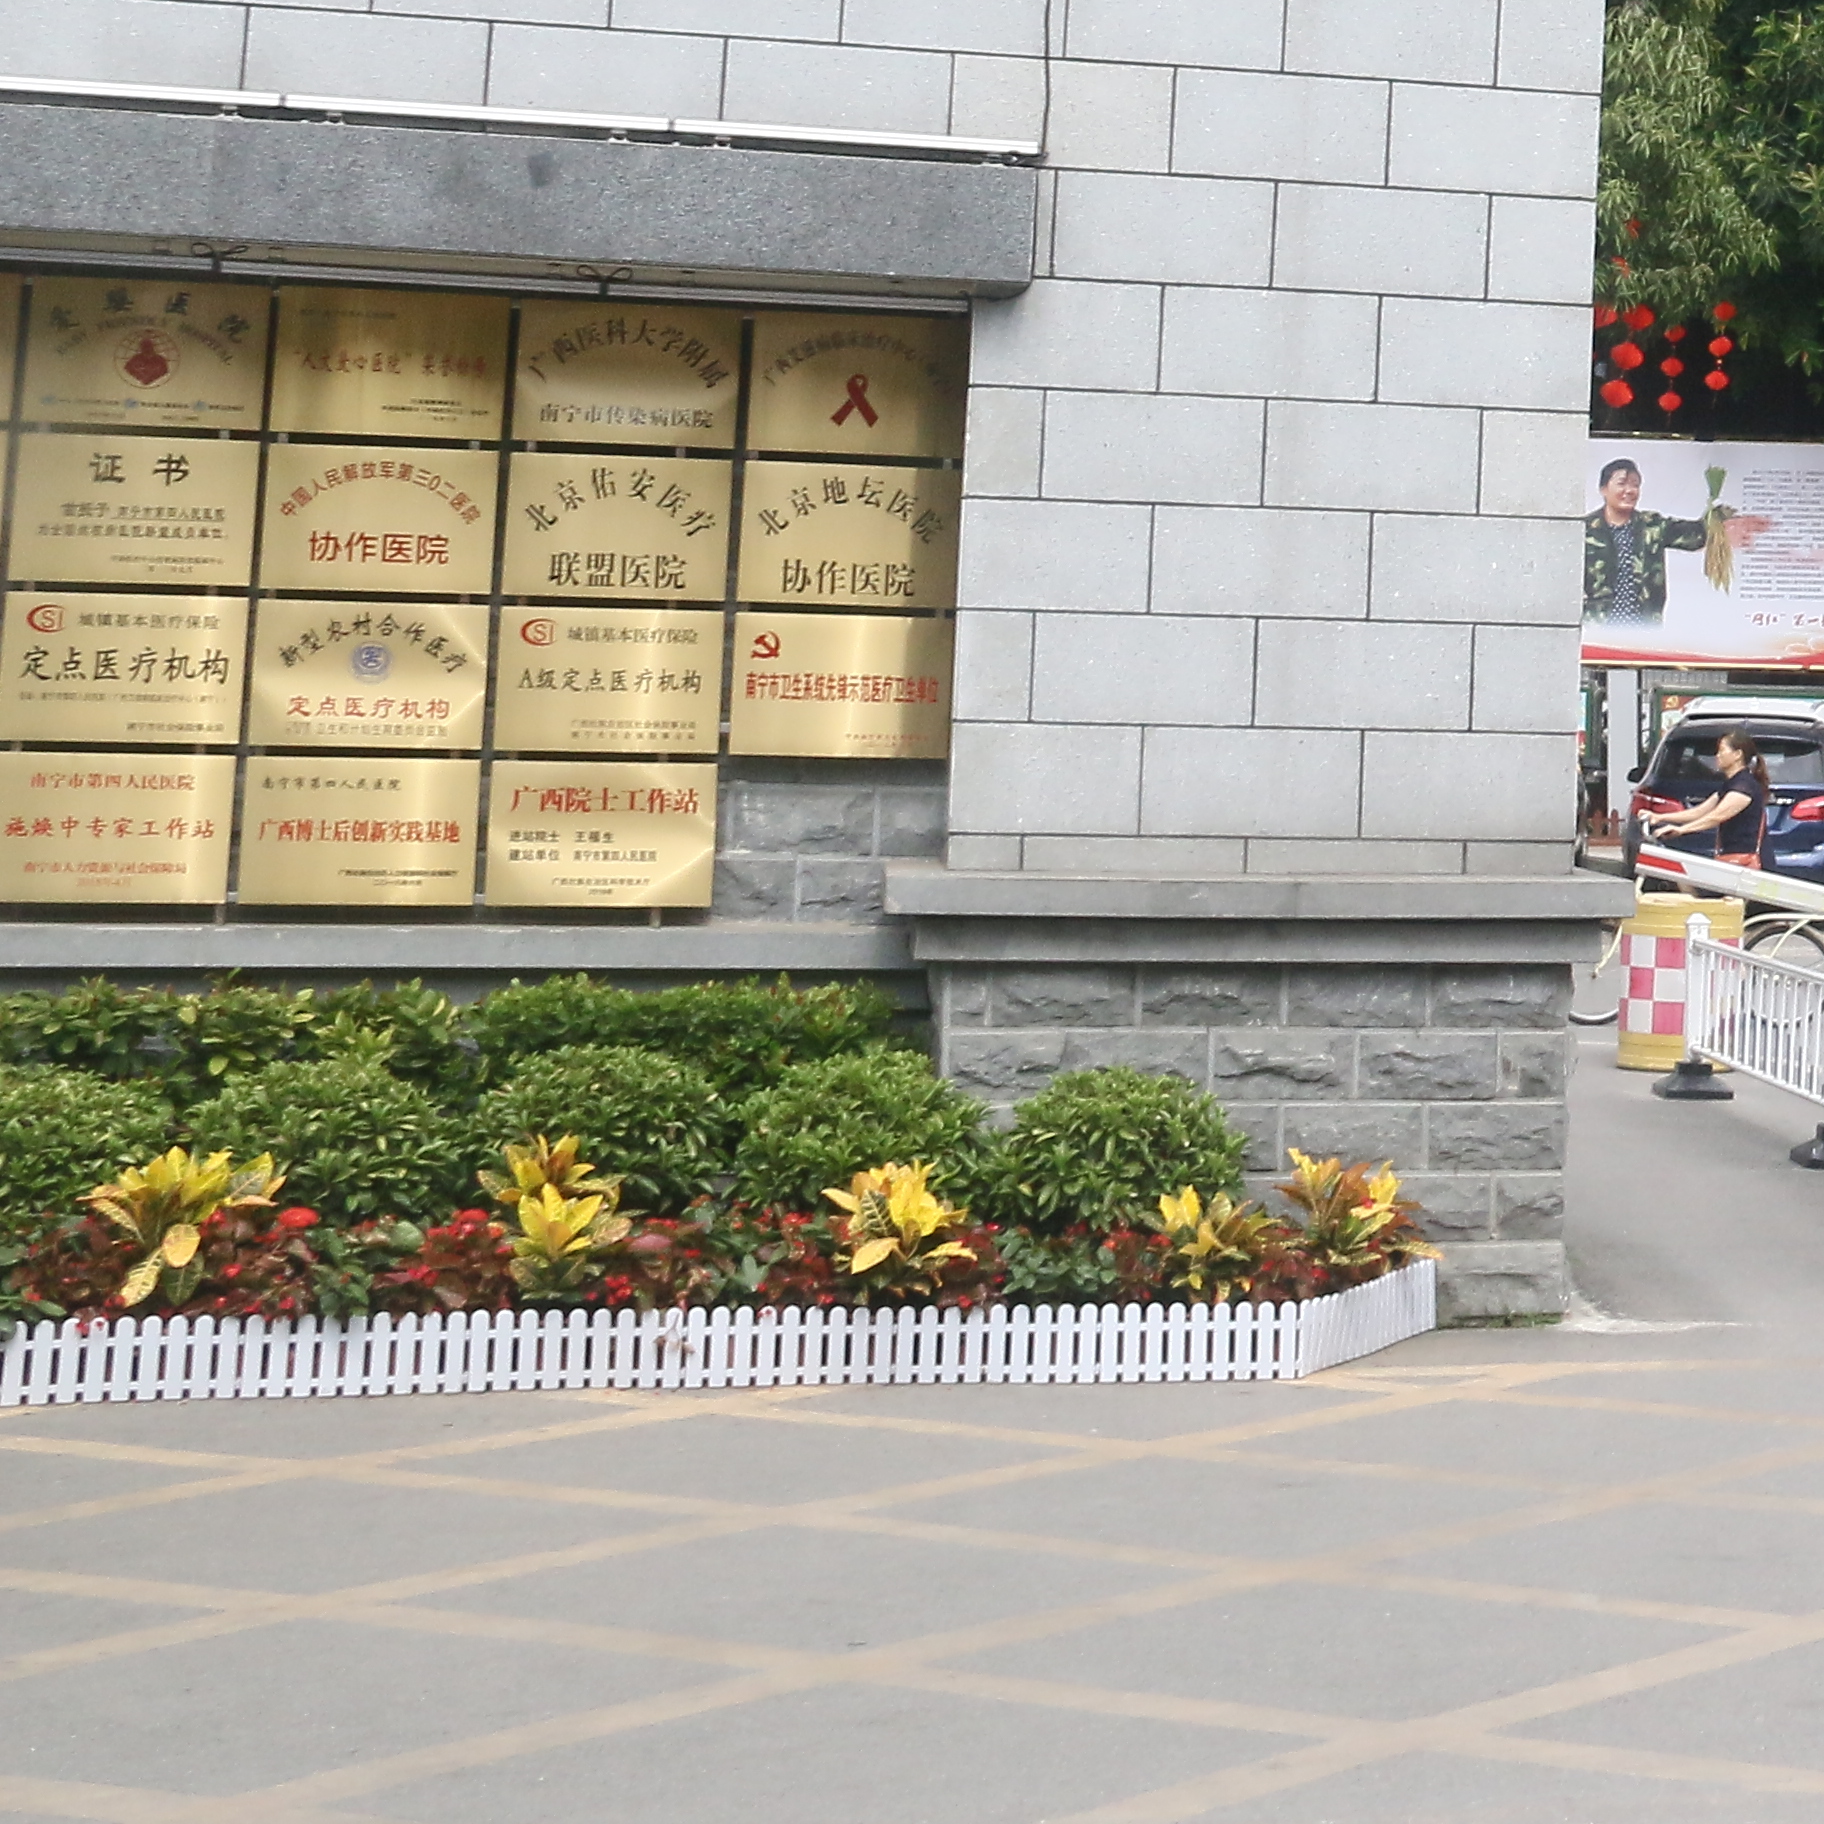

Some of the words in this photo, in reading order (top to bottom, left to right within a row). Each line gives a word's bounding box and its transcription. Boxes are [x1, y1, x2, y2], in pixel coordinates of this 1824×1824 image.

[528, 317, 729, 389] 广西医科大学附属
[539, 403, 714, 428] 南宁市传染病医院
[90, 452, 191, 487] 证书
[525, 467, 716, 537] 北京佑安医疗
[758, 476, 945, 545] 北京地坛医院
[308, 530, 450, 565] 协作医院
[548, 551, 688, 590] 联盟医院
[781, 558, 917, 598] 协作医院
[278, 612, 468, 674] 新型农村合作医疗
[566, 626, 699, 645] 城镇基本医疗保险
[19, 645, 231, 685] 定点医疗机构
[517, 667, 702, 695] A级定点医疗机构
[745, 671, 940, 705] 南宁市卫生系统先锋示范医疗卫生单位
[286, 696, 451, 720] 定点医疗机构
[29, 772, 197, 791] 南宁市第四人民医院
[261, 776, 402, 791] 南宁市第四人民医院
[510, 785, 700, 815] 广西院士工作站
[4, 815, 216, 840] 施焕中专家工作站
[258, 818, 461, 844] 广西博士后创新实践基地
